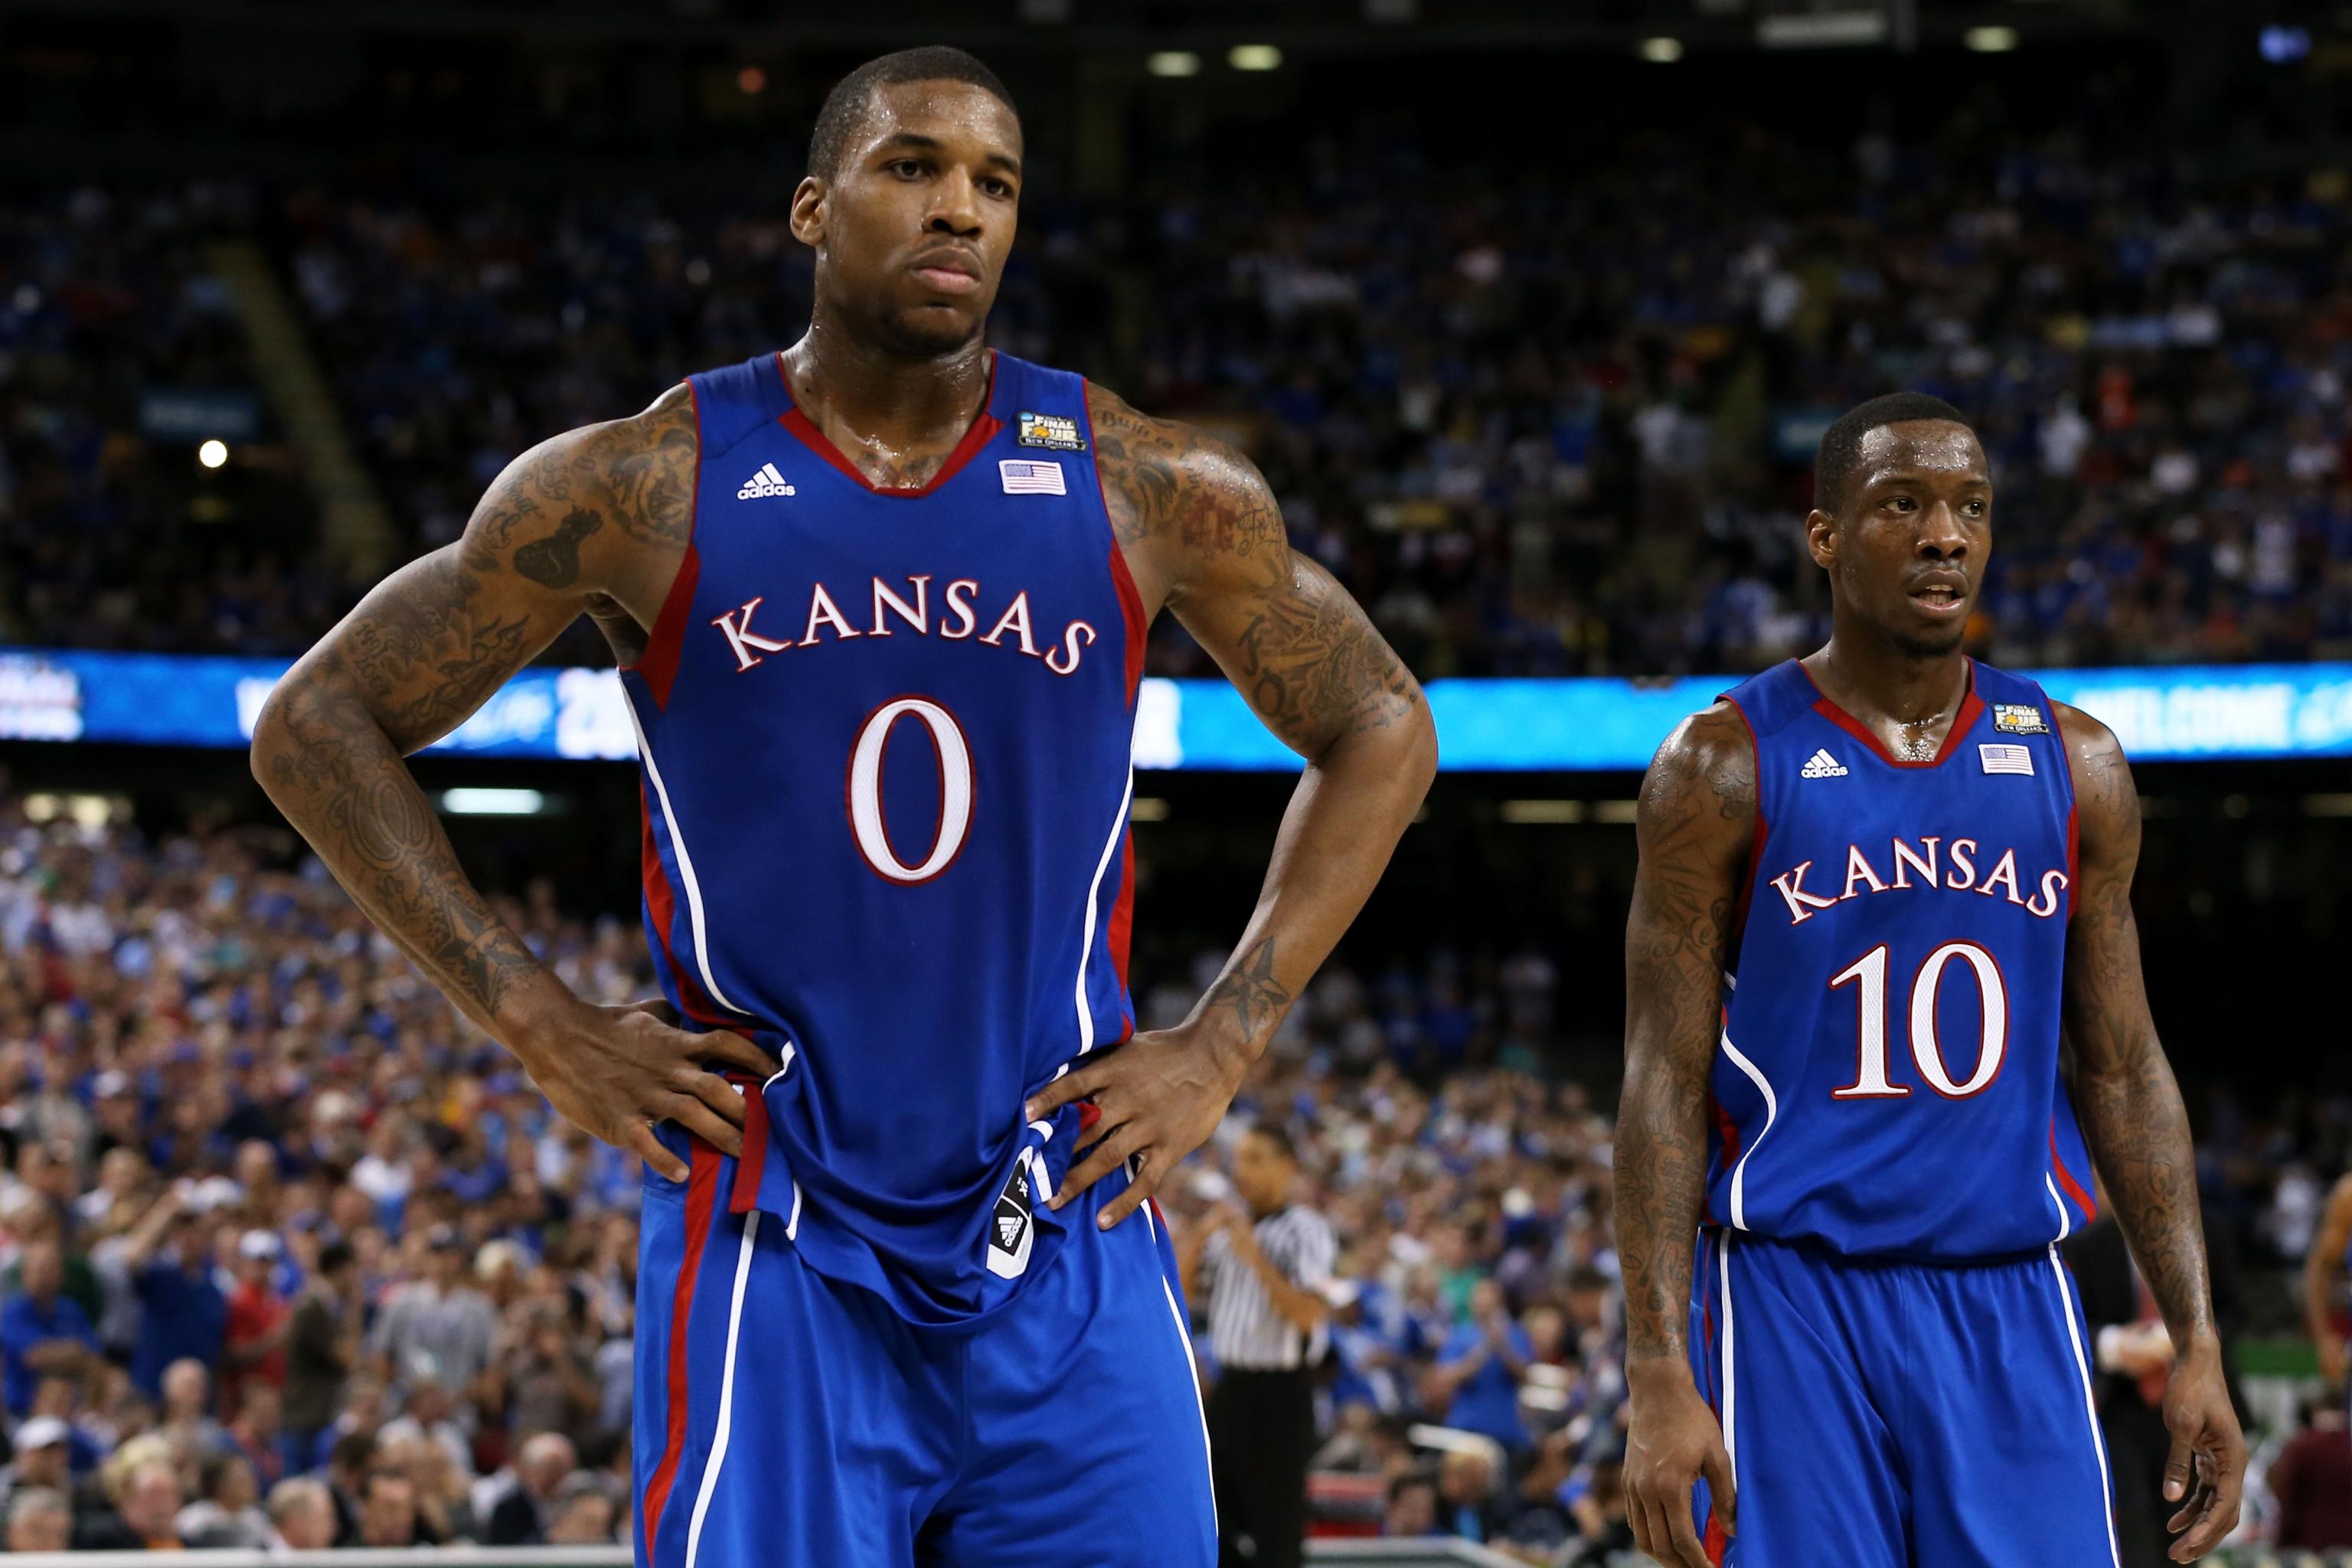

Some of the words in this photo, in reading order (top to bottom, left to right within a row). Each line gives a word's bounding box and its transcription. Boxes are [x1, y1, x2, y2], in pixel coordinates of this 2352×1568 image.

[1021, 421, 1077, 443] FOUR
[1034, 414, 1075, 430] FINAL
[737, 484, 796, 500] adidas
[710, 574, 1098, 675] KANSAS
[1995, 712, 2043, 726] FOUR
[2005, 704, 2038, 717] FINAL
[1801, 766, 1848, 779] adidas
[849, 697, 973, 883] 0
[1769, 835, 2069, 926] KANSAS
[1828, 938, 2011, 1100] 10
[1004, 1215, 1024, 1247] adidas
